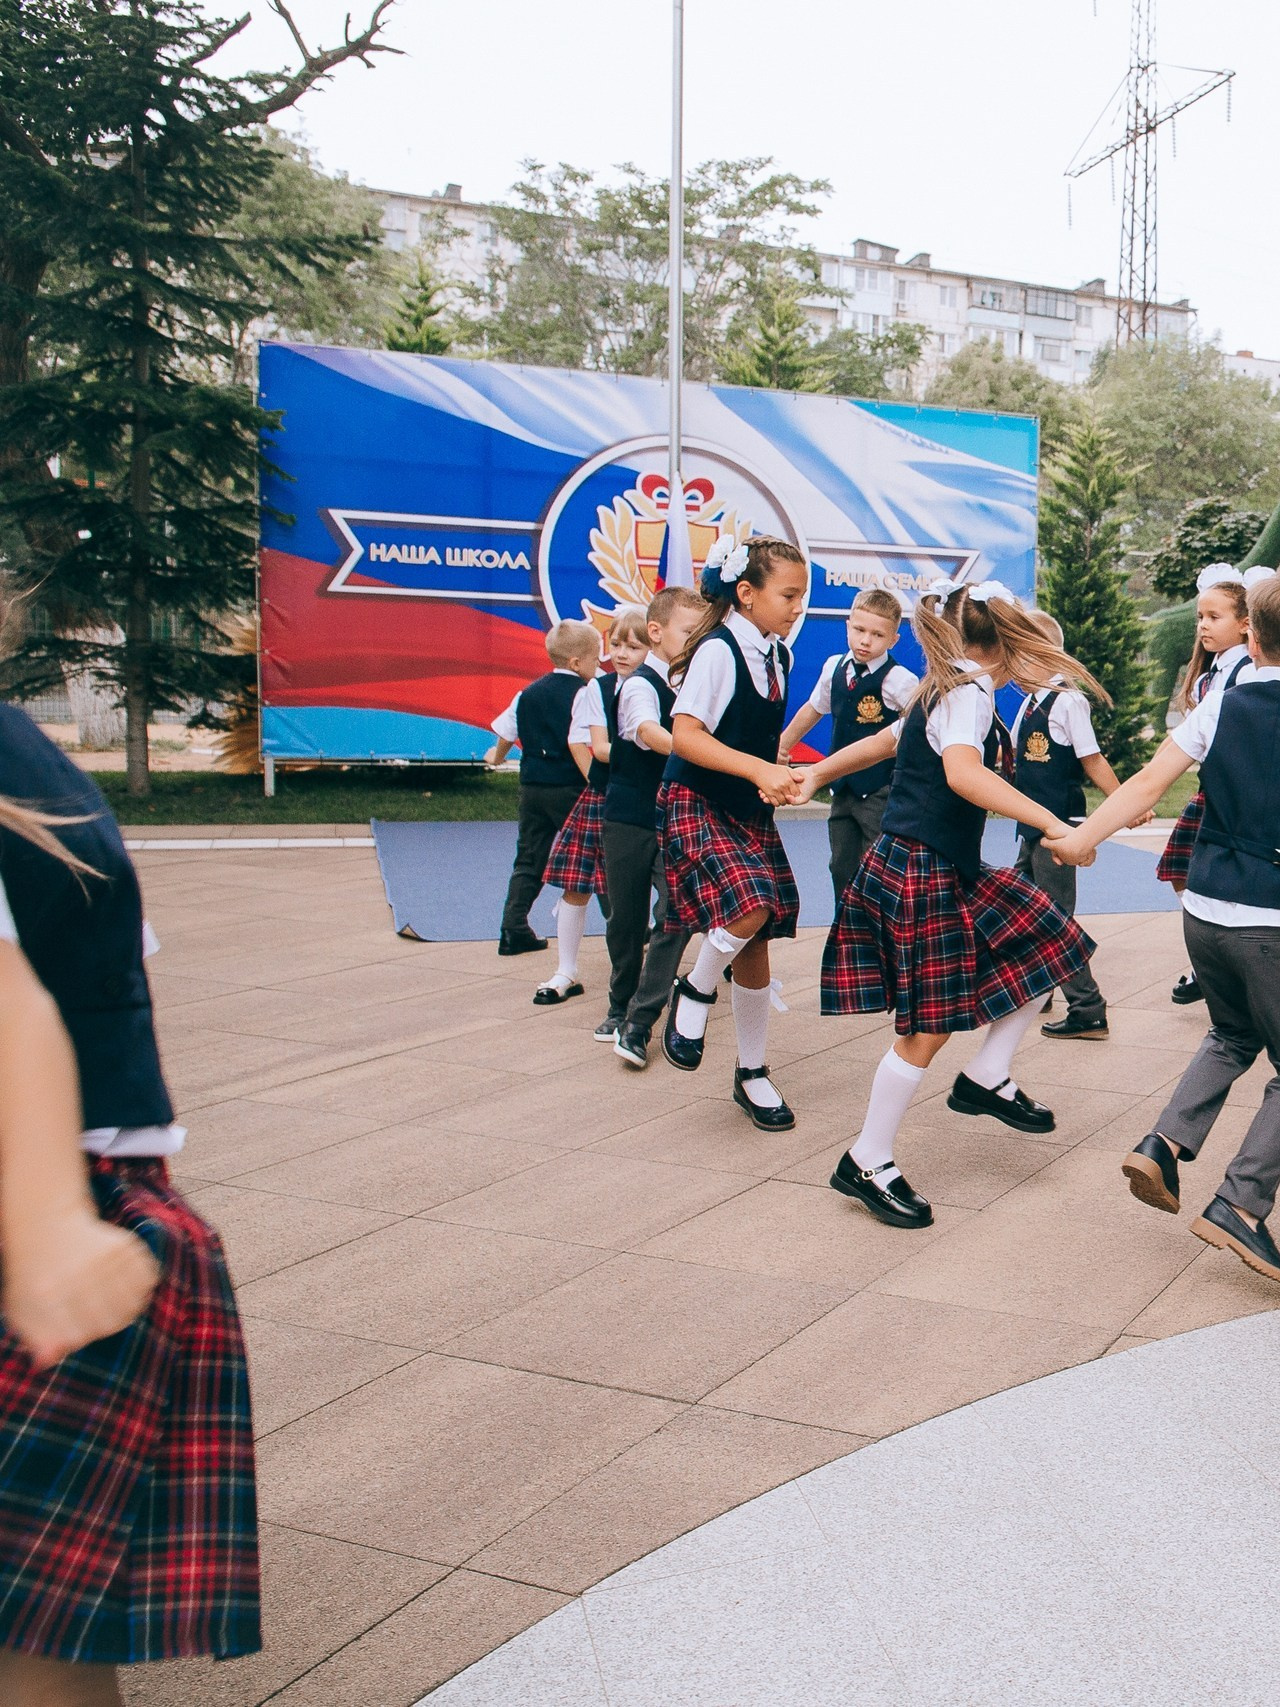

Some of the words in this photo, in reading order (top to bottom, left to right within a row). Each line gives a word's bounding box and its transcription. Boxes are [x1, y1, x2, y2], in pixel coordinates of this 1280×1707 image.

[370, 543, 442, 565] НАША
[446, 547, 531, 570] ШКОЛА
[826, 571, 880, 589] НАША
